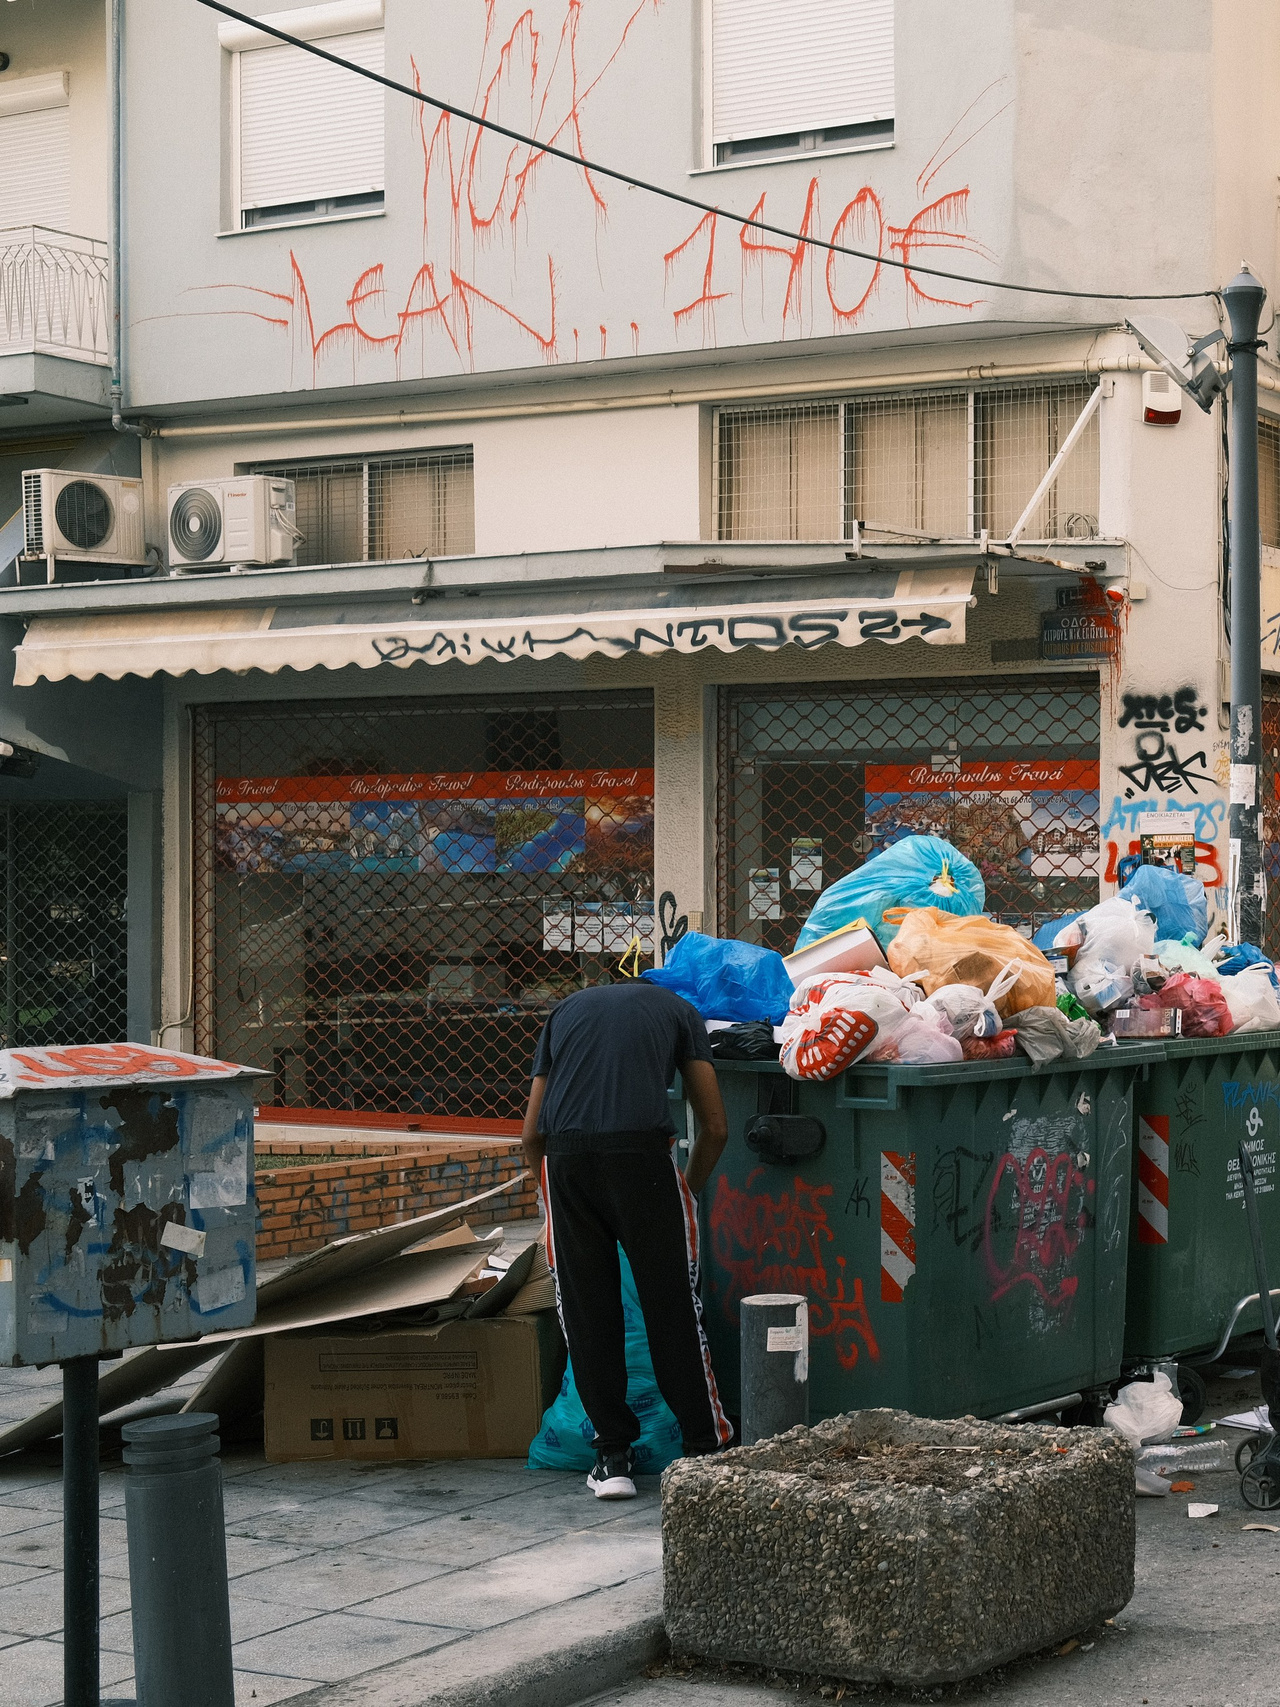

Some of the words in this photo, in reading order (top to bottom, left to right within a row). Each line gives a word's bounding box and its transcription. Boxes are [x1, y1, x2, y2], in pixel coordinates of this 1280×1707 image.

[1061, 616, 1096, 628] ΟΔΟΣ
[505, 773, 585, 796] Rodopoulos
[590, 770, 639, 789] Travel
[908, 764, 1003, 787] Rodopoulos
[1008, 764, 1064, 783] Travel
[236, 778, 279, 796] Travel
[1246, 1139, 1265, 1152] ΗΜΟΣ
[1227, 1152, 1276, 1172] ΘΕΣΟΝΙΚΗΣ
